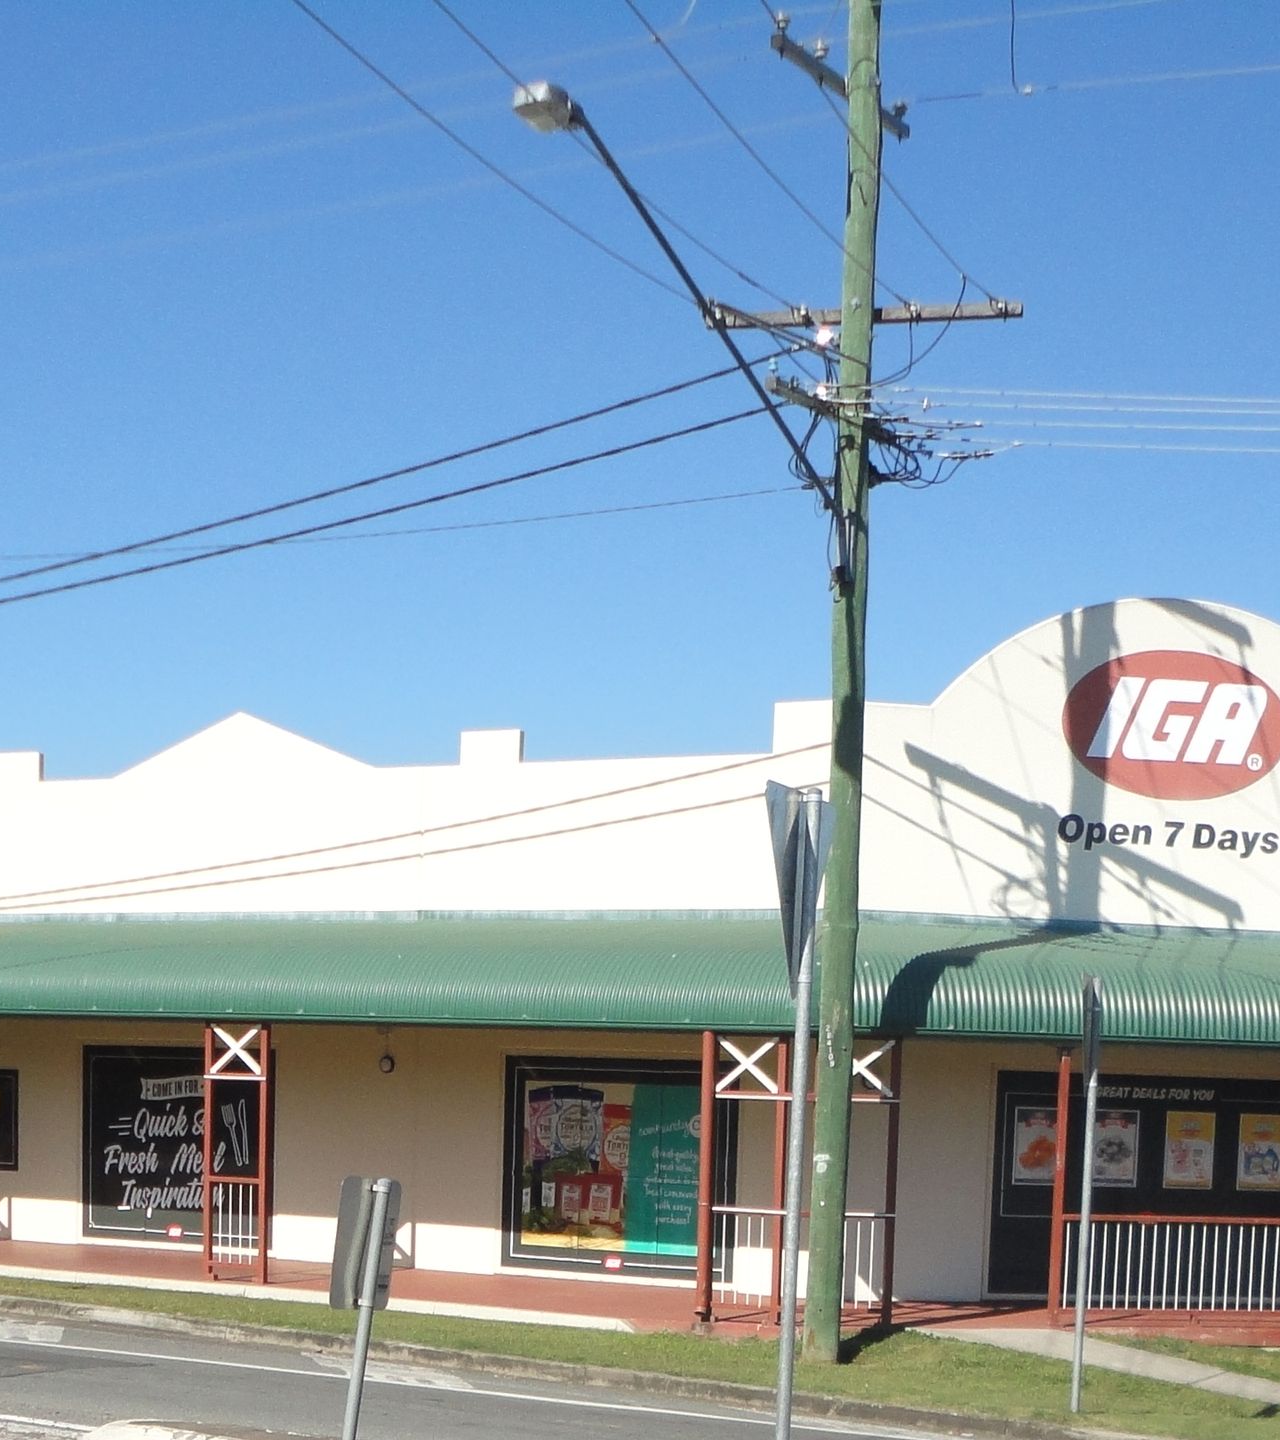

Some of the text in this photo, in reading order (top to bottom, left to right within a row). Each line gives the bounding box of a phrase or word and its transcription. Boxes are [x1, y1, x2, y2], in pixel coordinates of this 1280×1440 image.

[1086, 676, 1268, 765] IGA
[1058, 813, 1280, 859] Open 7 Days
[152, 1080, 199, 1098] COME IN FOR
[1096, 1086, 1215, 1101] GREAT DEALS FOR YOU
[133, 1103, 189, 1143] Quick
[104, 1141, 226, 1175] Fresh Mel
[118, 1177, 225, 1218] Inspiratin
